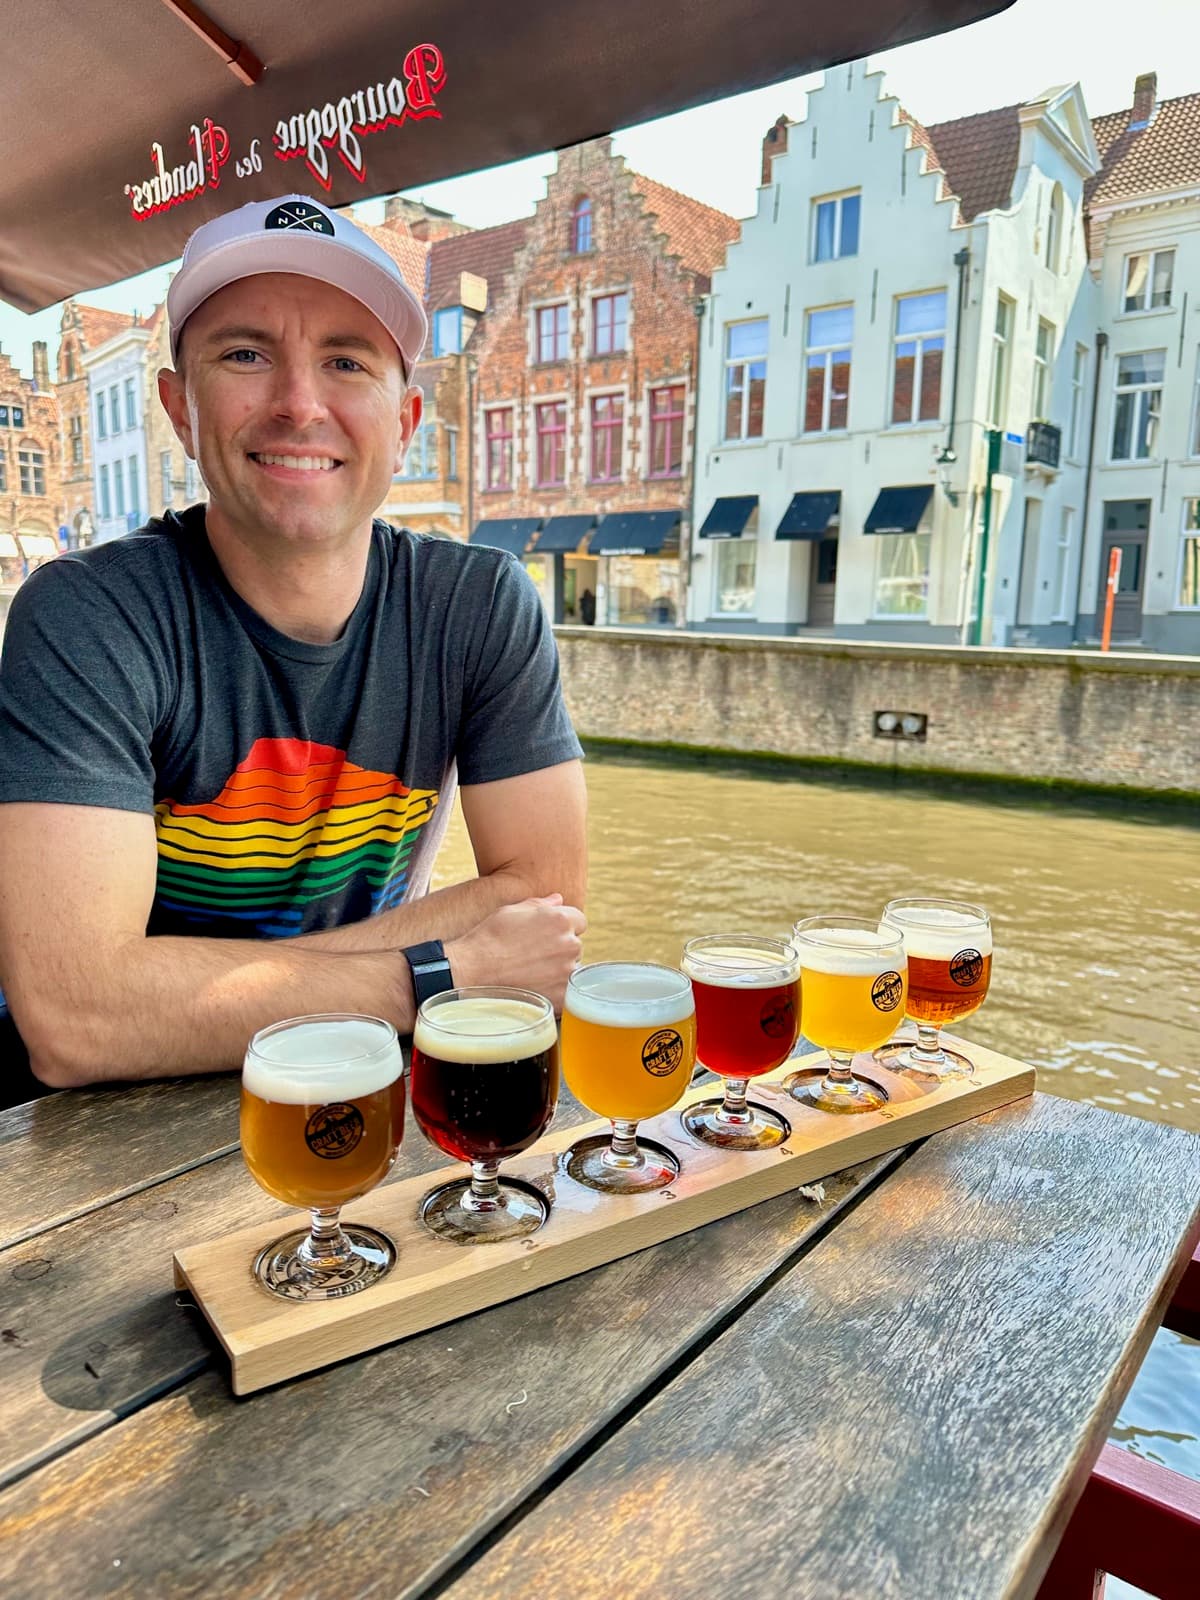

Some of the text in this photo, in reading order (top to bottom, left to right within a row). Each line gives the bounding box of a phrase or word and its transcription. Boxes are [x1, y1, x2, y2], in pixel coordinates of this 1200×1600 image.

[880, 1110, 895, 1119] 5
[311, 1130, 338, 1151] CRAFT
[779, 1147, 794, 1157] 4
[659, 1190, 677, 1200] 3
[520, 1239, 539, 1250] 2
